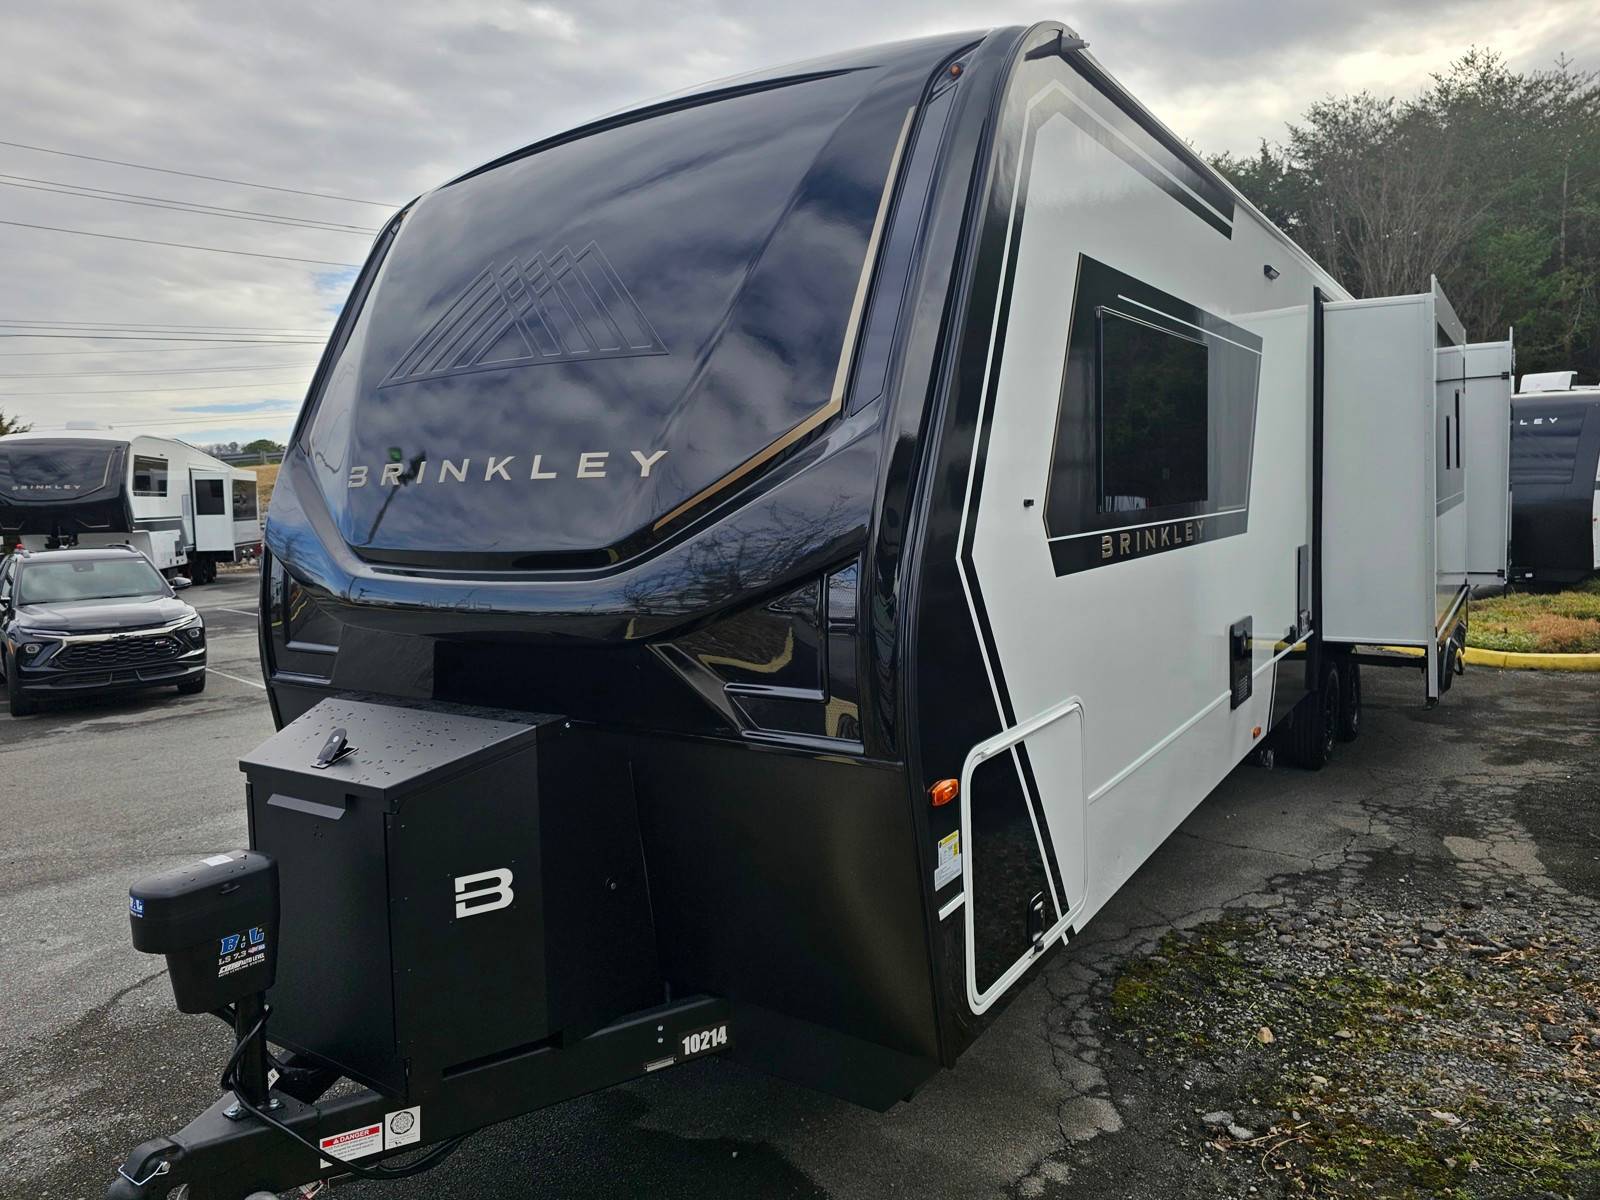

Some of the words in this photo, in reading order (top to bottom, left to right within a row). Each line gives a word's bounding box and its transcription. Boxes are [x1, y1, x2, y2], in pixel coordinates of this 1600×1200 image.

[347, 450, 669, 488] BRINKLEY
[1101, 520, 1204, 559] BRINKLEY
[454, 867, 514, 919] B
[682, 1025, 728, 1056] 10214
[339, 1129, 370, 1143] DANGER
